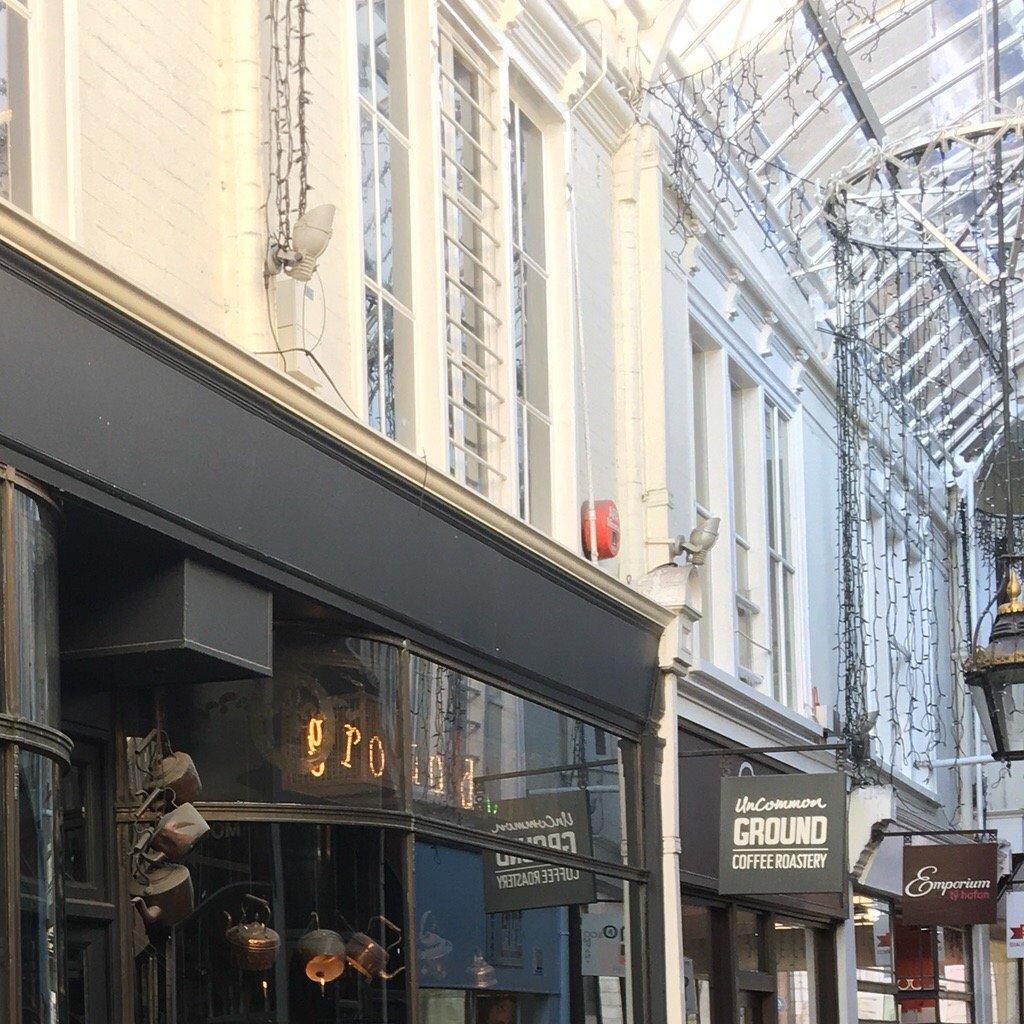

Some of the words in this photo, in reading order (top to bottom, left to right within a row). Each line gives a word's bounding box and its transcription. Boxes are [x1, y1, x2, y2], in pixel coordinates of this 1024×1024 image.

[734, 796, 828, 814] UnCommon
[733, 815, 828, 846] GROUND
[732, 854, 774, 870] COFFEE
[775, 853, 828, 869] ROASTERY
[904, 865, 991, 897] Emporium
